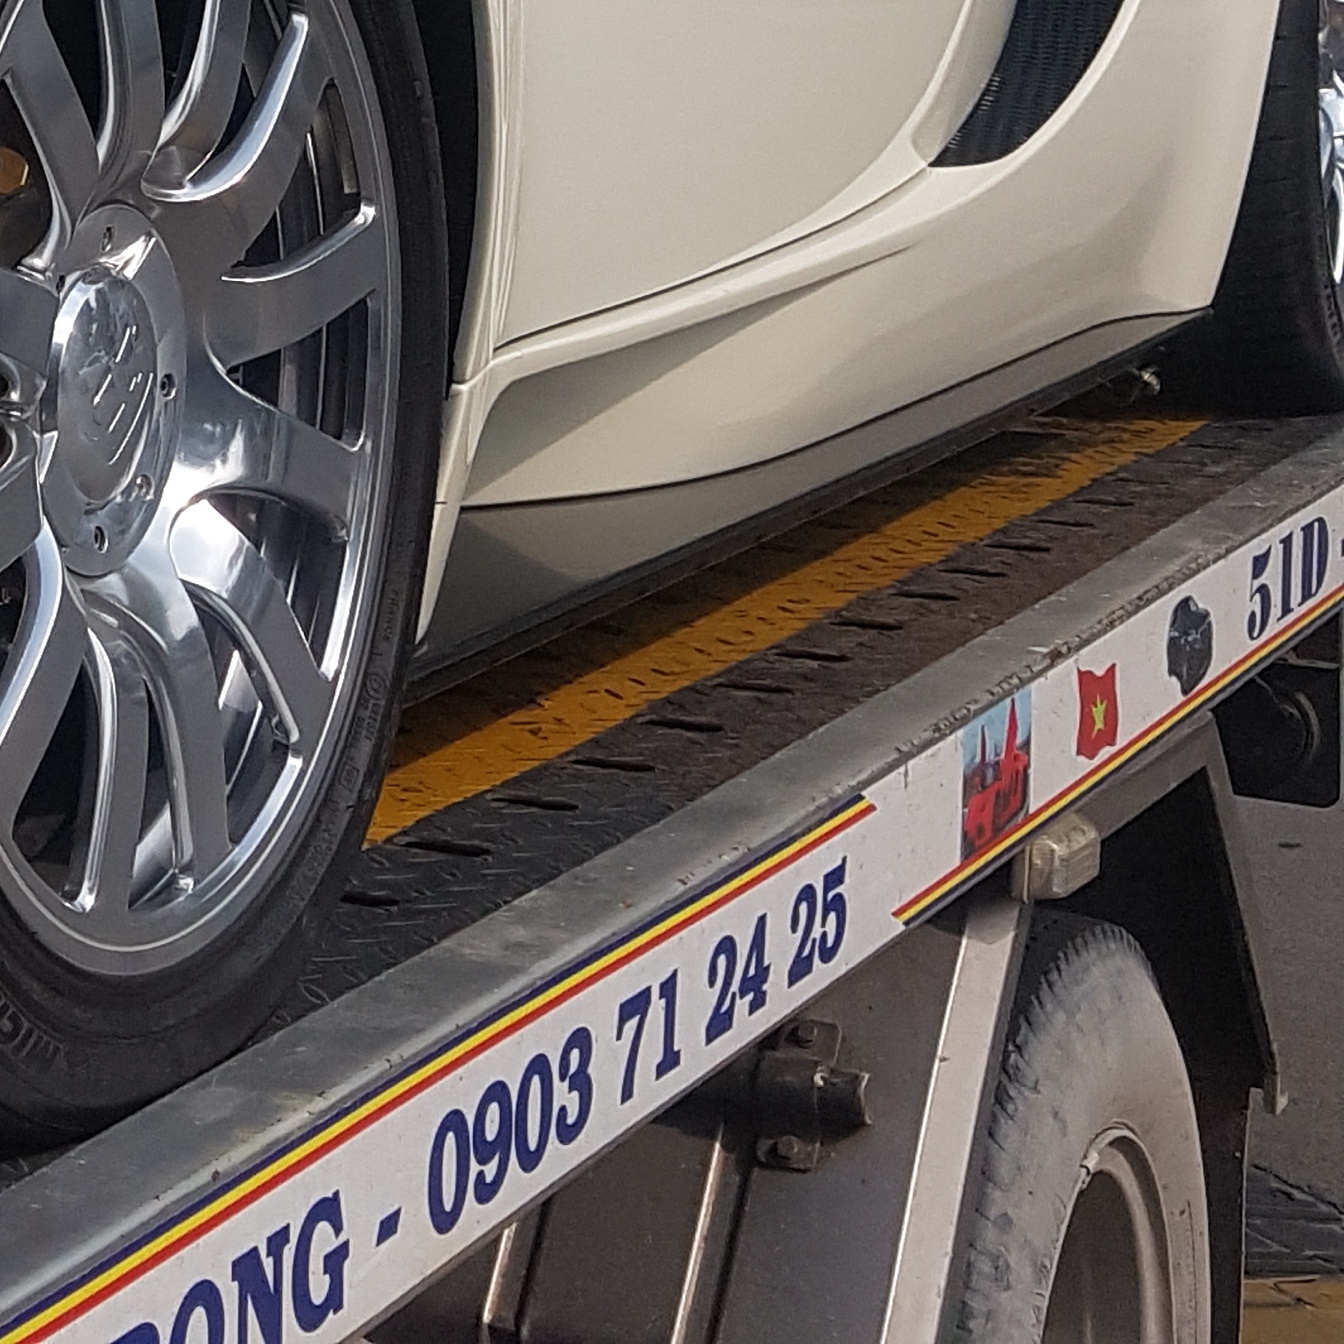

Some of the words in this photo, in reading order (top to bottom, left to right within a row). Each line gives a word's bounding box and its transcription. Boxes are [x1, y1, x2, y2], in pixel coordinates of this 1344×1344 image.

[1247, 516, 1329, 641] 51D
[109, 1189, 351, 1344] ONG
[427, 1026, 594, 1235] 0903
[615, 968, 682, 1105] 71
[705, 913, 773, 1046] 24
[788, 855, 848, 988] 25
